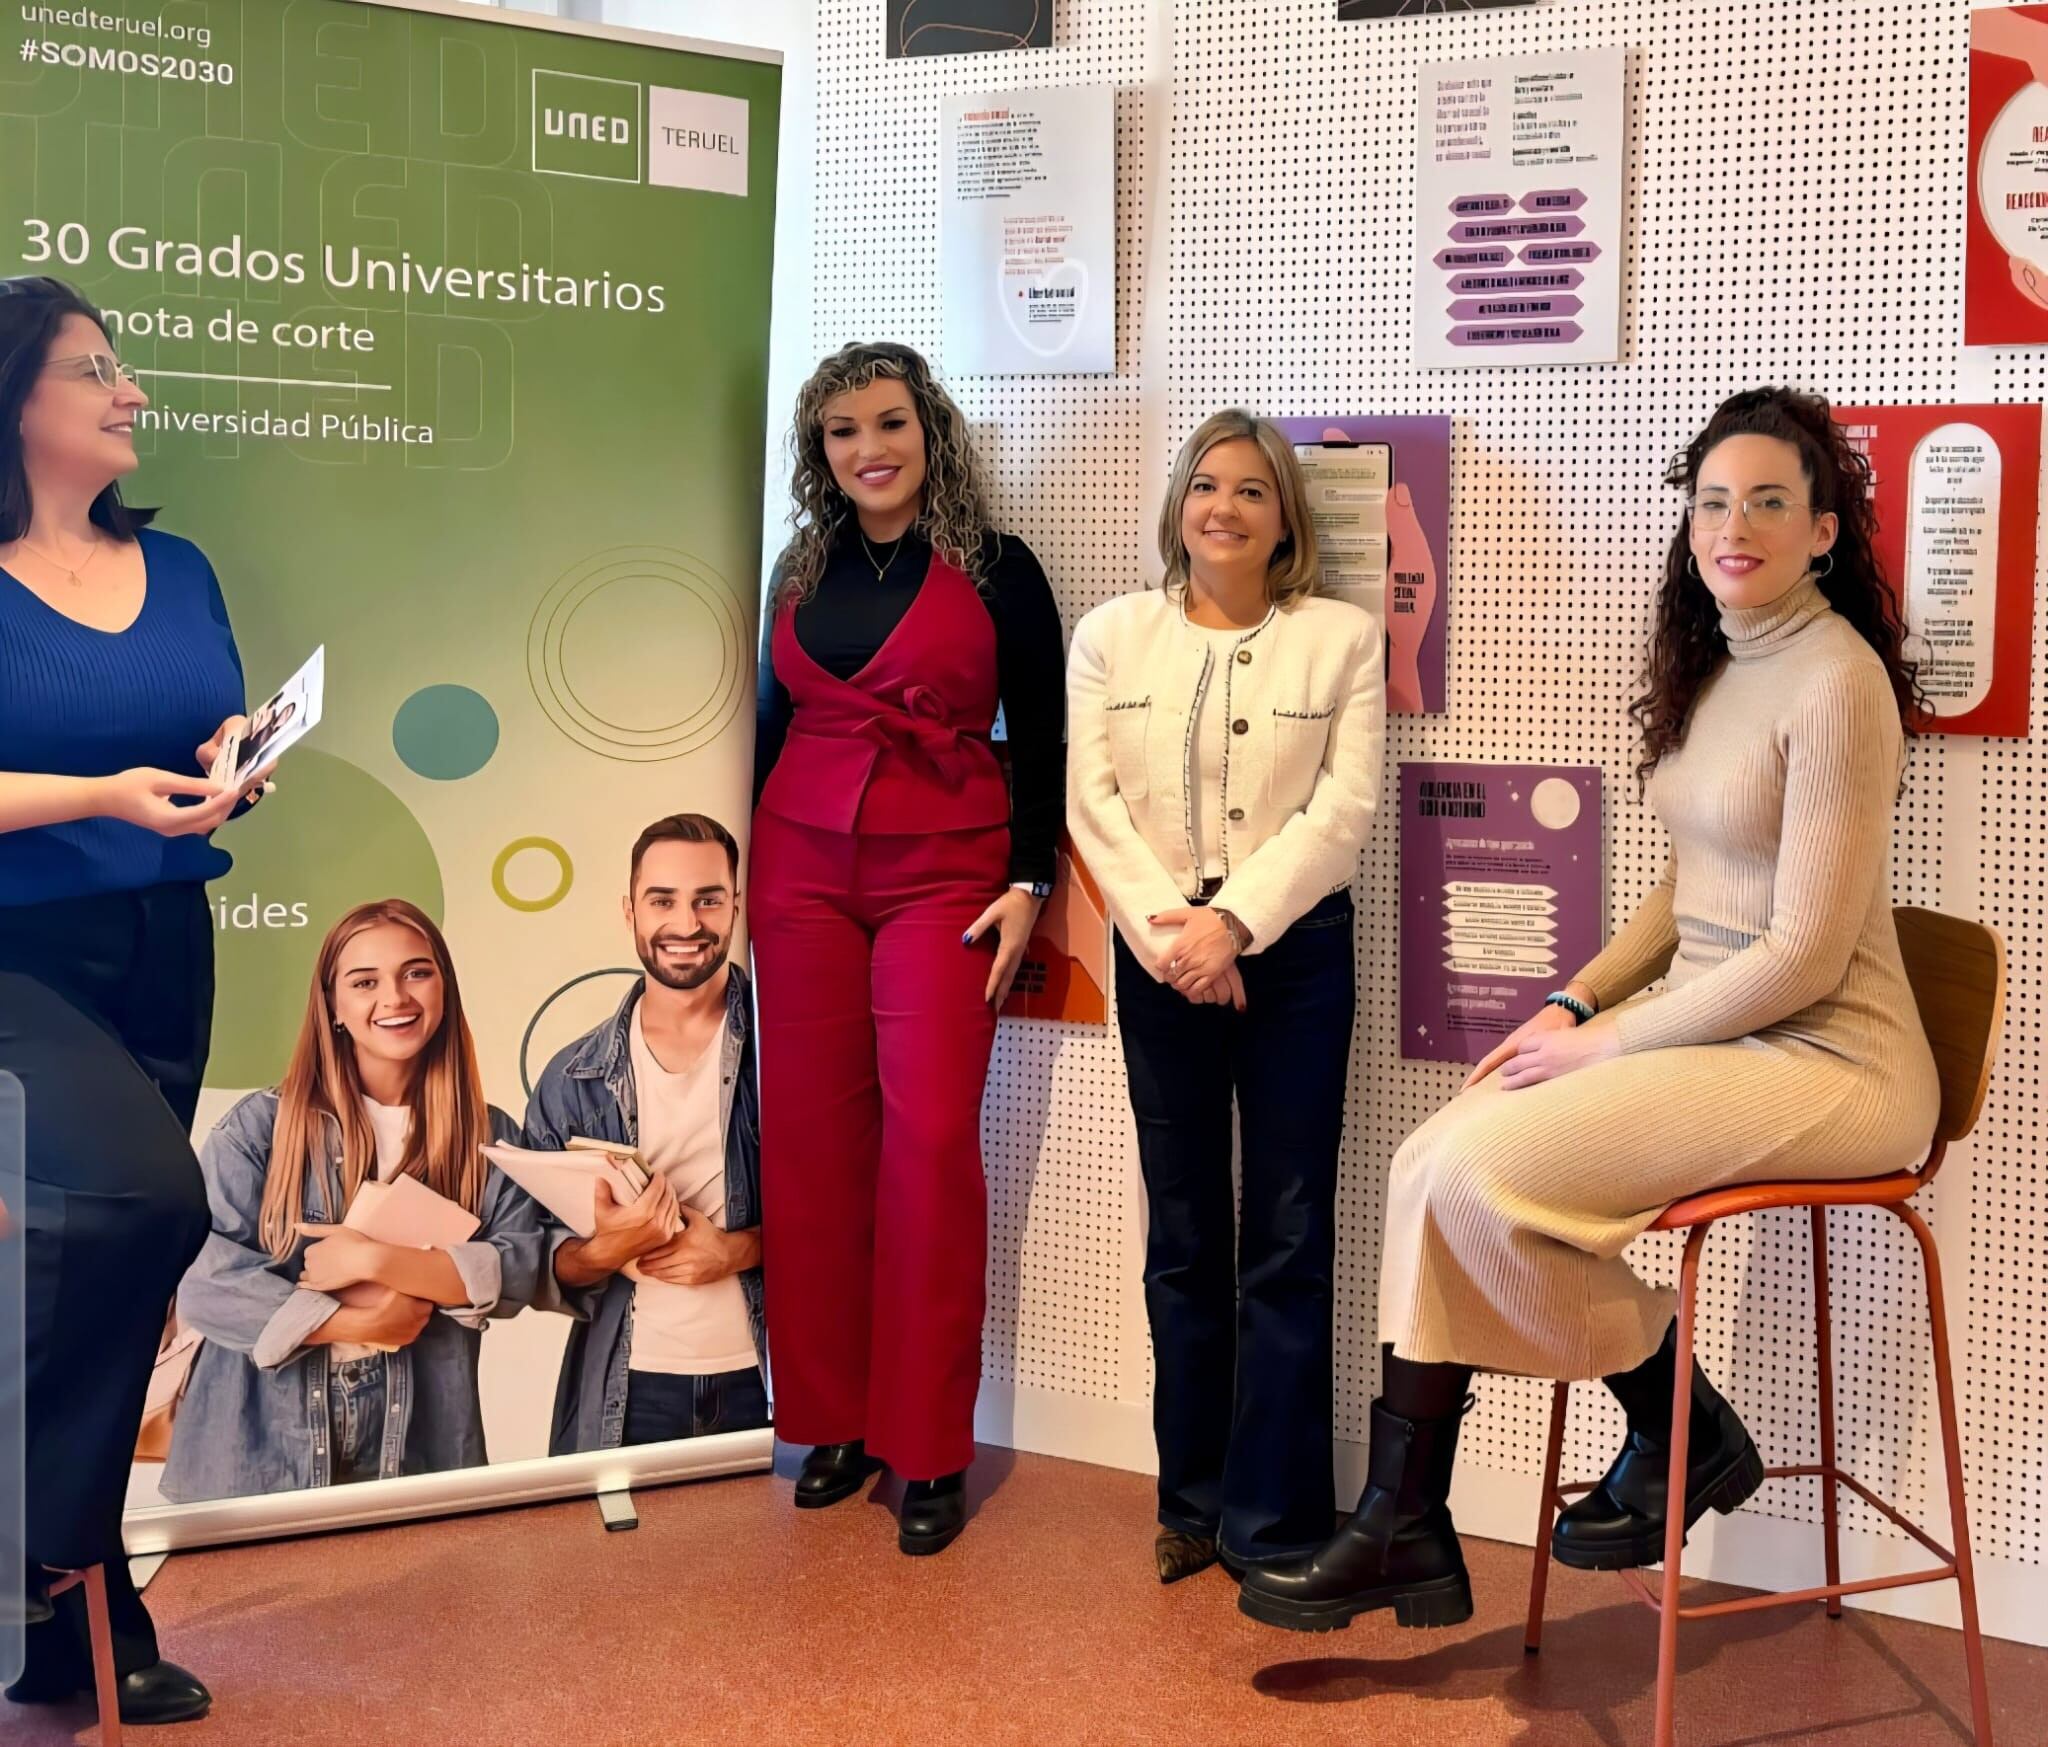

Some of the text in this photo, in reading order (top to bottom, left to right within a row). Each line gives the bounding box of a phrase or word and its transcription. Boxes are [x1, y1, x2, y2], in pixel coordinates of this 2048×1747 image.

[22, 5, 211, 48] unedteruel.org
[20, 38, 233, 85] #SOMOS2030
[544, 108, 629, 145] UNED
[661, 126, 740, 155] TERUEL
[21, 219, 665, 313] 30 Grados Universitarios
[100, 308, 375, 352] nota de corte
[322, 414, 433, 444] Pública
